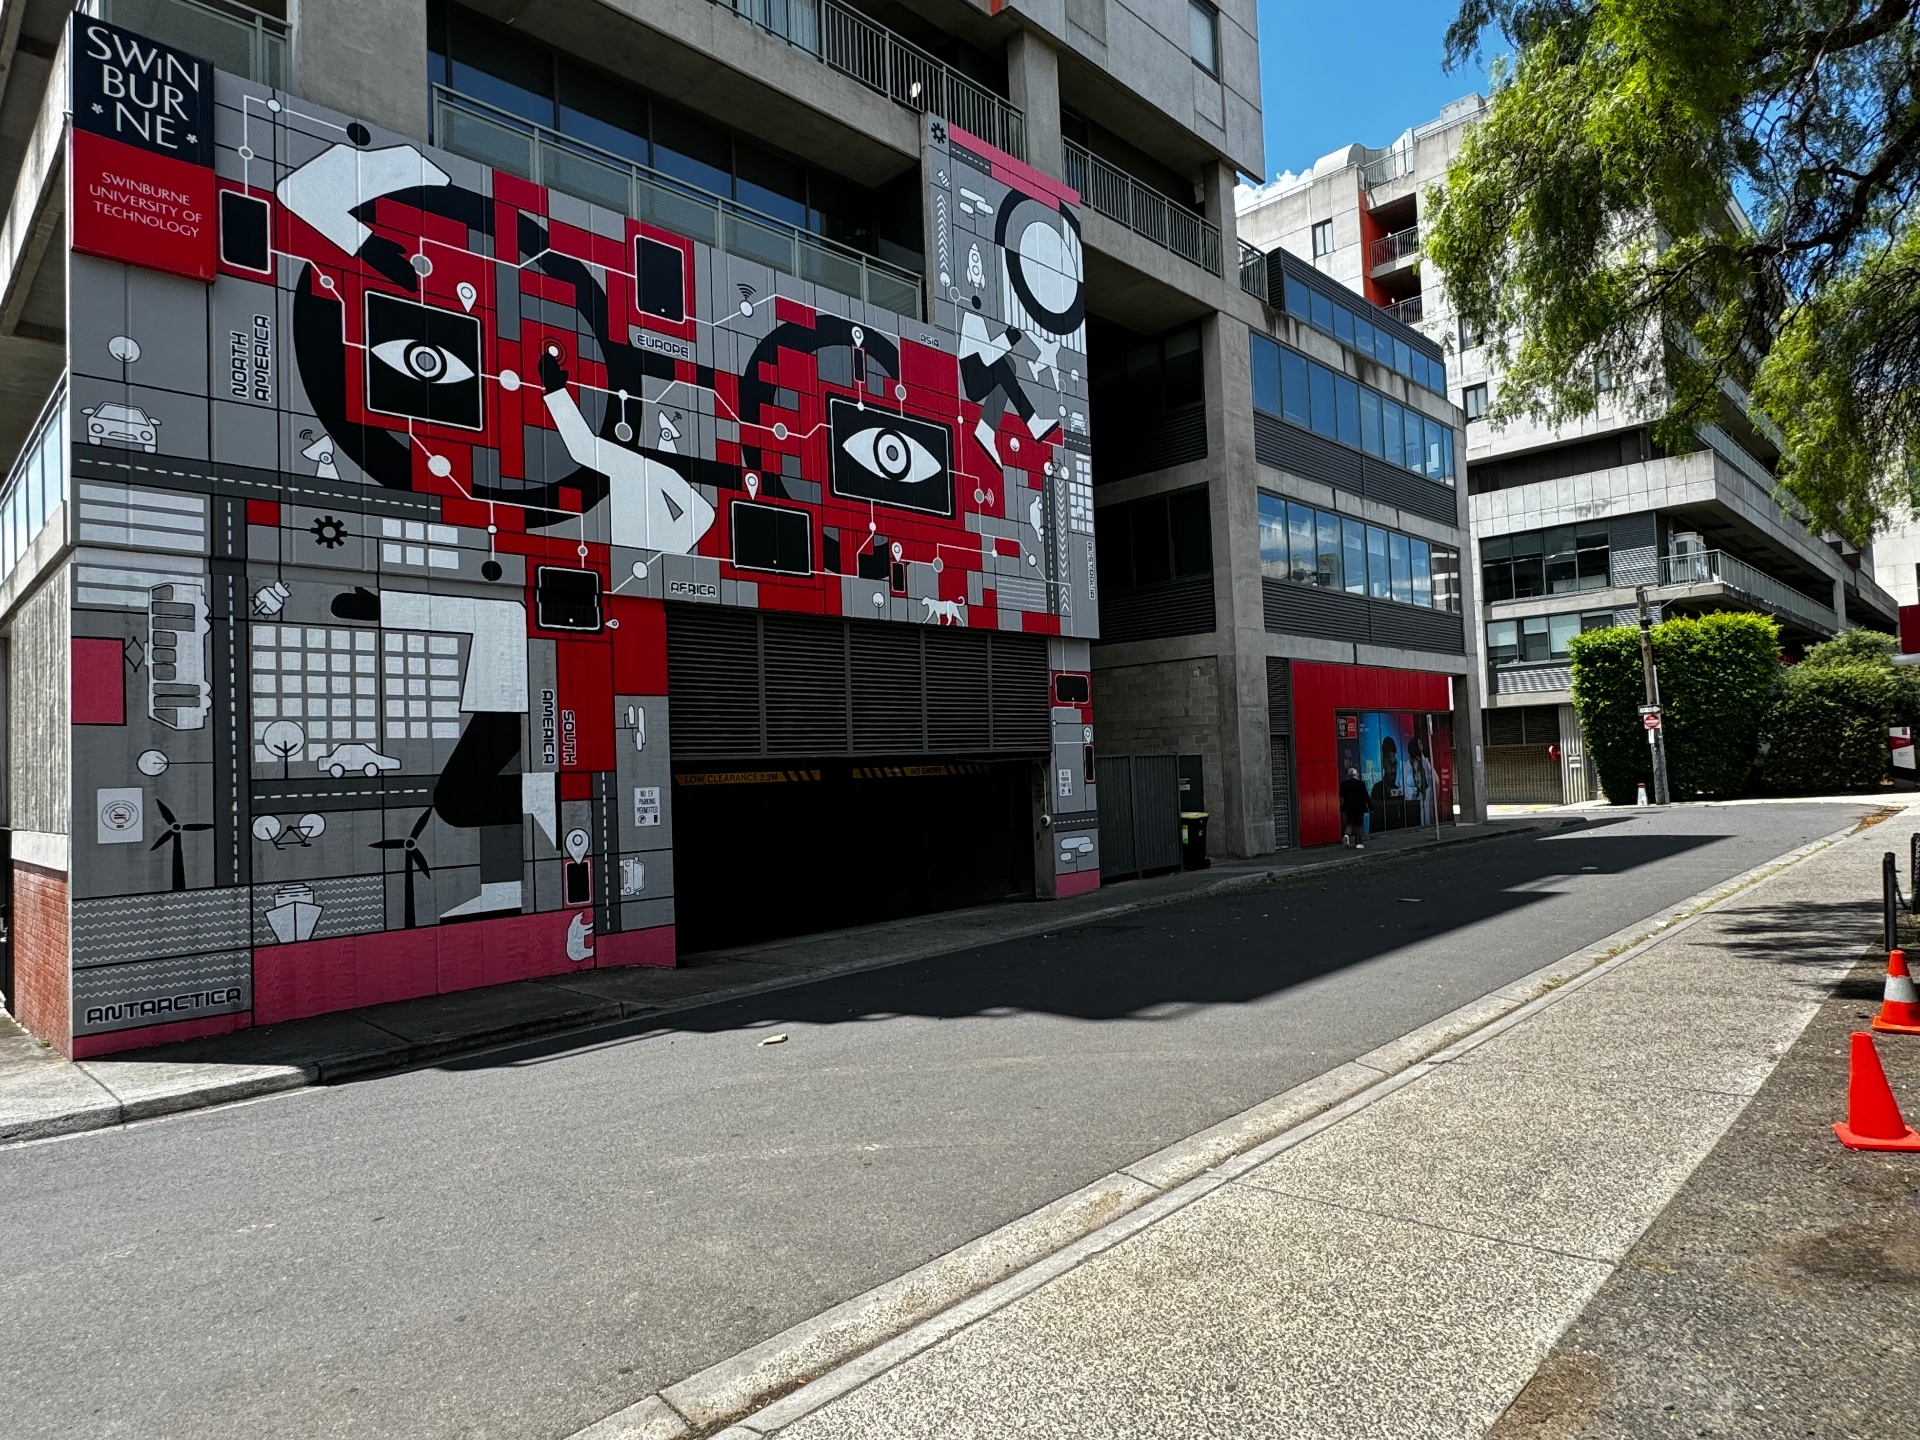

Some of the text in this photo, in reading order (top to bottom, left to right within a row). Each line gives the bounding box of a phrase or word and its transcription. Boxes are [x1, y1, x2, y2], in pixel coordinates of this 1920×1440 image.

[103, 64, 190, 121] BUR
[116, 101, 178, 149] NE
[89, 183, 202, 223] UNIVERSITY OF
[102, 172, 190, 206] SWINBURNE
[93, 200, 199, 238] TECHNOLOGY
[254, 314, 270, 402] AMERICA
[637, 334, 689, 359] EUROPE
[920, 334, 940, 348] ASIA
[231, 331, 248, 398] NORTH
[670, 581, 716, 597] AFRICA
[1087, 541, 1095, 599] AUSTRALIA
[542, 689, 556, 764] AMERICA
[562, 710, 576, 764] SOUTH
[685, 773, 779, 784] LOW CLEARANCE 2.2M
[922, 767, 941, 775] ENTRY
[86, 987, 242, 1024] ANTARCTICA
